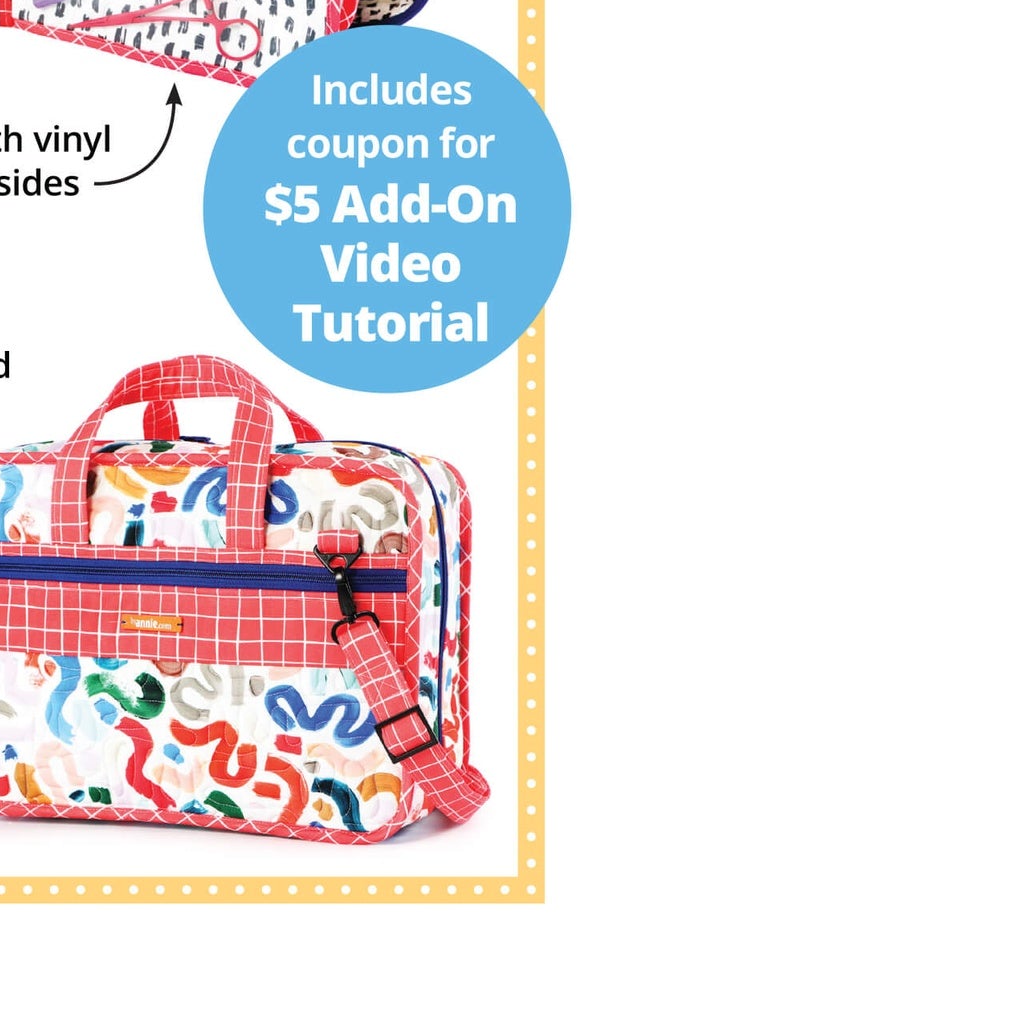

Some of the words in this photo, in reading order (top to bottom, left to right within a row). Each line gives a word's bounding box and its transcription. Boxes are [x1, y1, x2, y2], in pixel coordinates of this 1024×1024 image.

[312, 72, 473, 106] Includes
[33, 124, 111, 161] vinyl
[287, 133, 429, 168] coupon
[439, 126, 497, 159] for
[265, 182, 320, 226] $5
[332, 182, 517, 223] Add-On
[320, 241, 461, 283] Video
[292, 301, 488, 342] Tutorial
